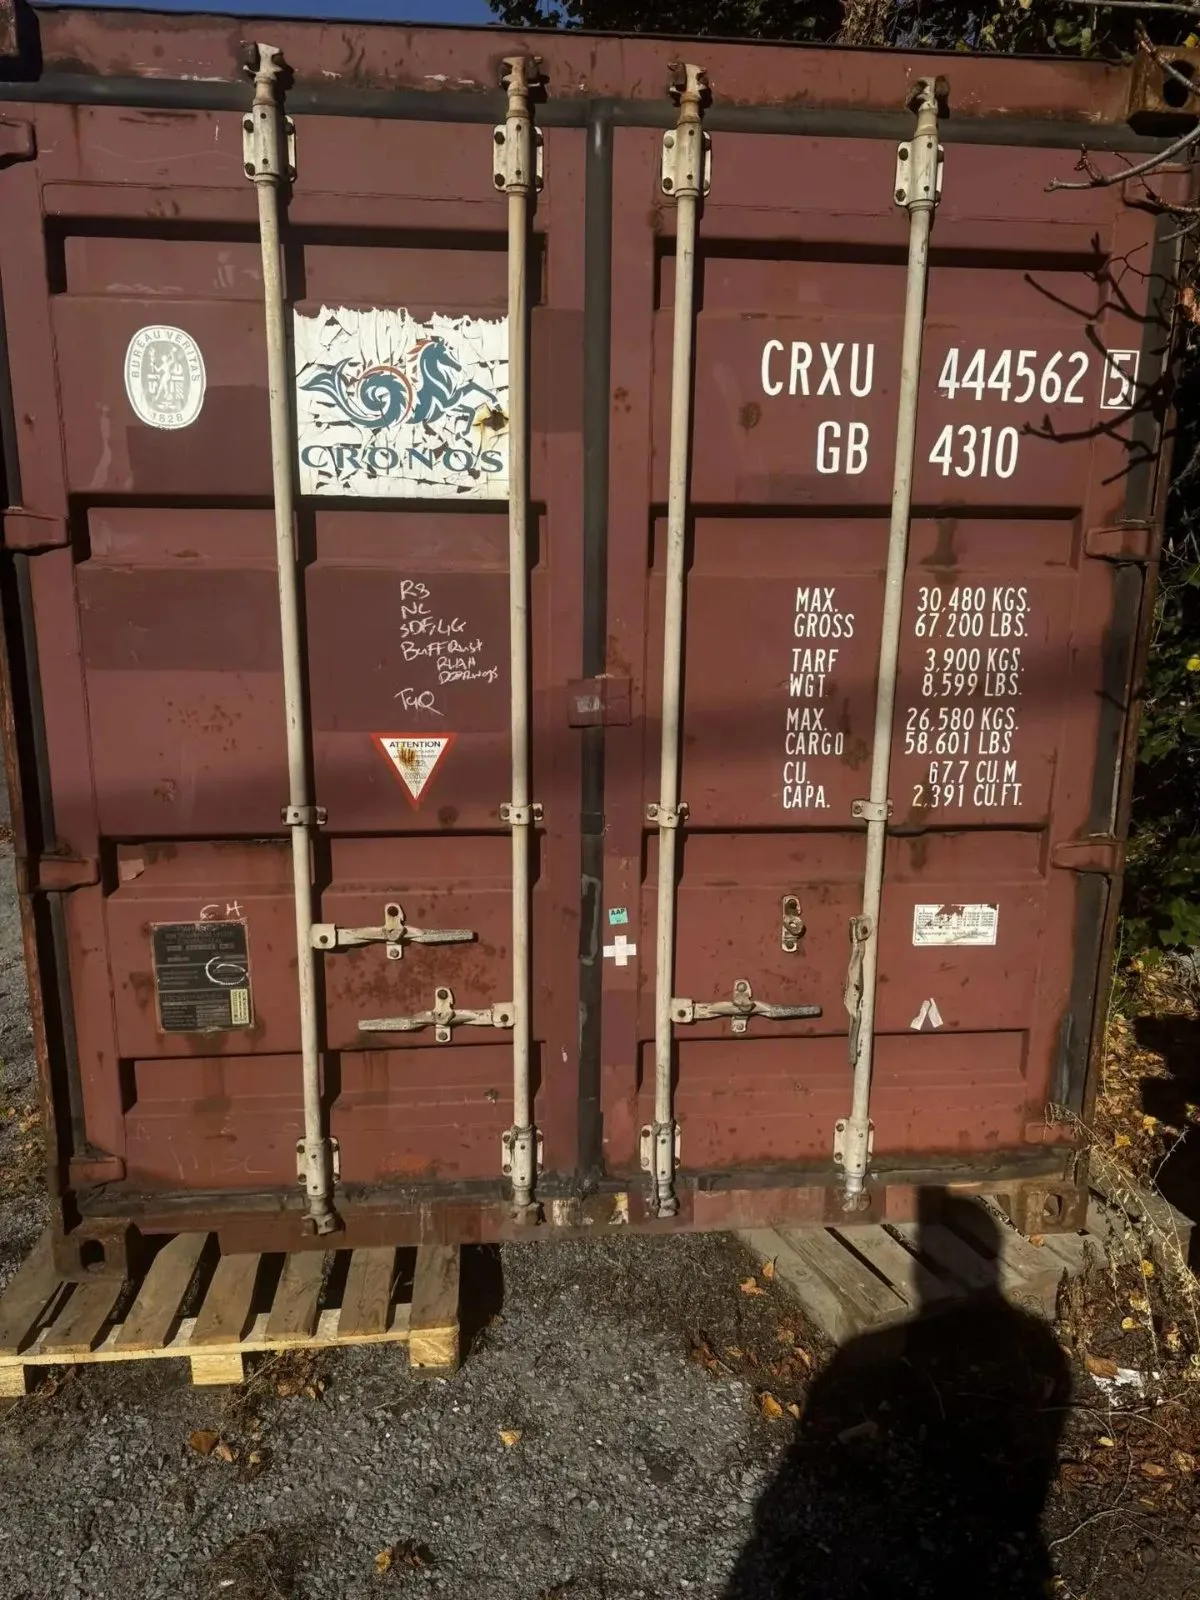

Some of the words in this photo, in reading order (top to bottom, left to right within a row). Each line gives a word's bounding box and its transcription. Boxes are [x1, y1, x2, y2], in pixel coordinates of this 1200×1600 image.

[132, 330, 161, 378] BUREAU
[167, 330, 201, 382] VERITAS
[761, 339, 875, 398] CRXU
[937, 347, 1090, 404] 444562
[152, 412, 184, 424] 1828
[301, 445, 504, 473] CRONOS
[815, 420, 870, 475] GB
[928, 424, 1020, 479] 4310
[795, 587, 839, 613] MAX.
[917, 586, 986, 613] 30,480
[992, 586, 1031, 612] KGS.
[794, 612, 855, 638] GROSS
[990, 612, 1028, 638] LBS.
[924, 647, 981, 673] 3,900
[986, 646, 1025, 672] KGS.
[921, 672, 978, 698] 8,599
[984, 672, 1023, 697] LBS.
[786, 707, 828, 732] MAX.
[906, 707, 975, 732] 26,580
[980, 706, 1019, 731] KGS.
[785, 731, 844, 756] CARGO
[783, 760, 811, 785] CU.
[928, 760, 970, 784] 67.7
[782, 785, 831, 809] CAPA.
[912, 784, 965, 808] 2,391
